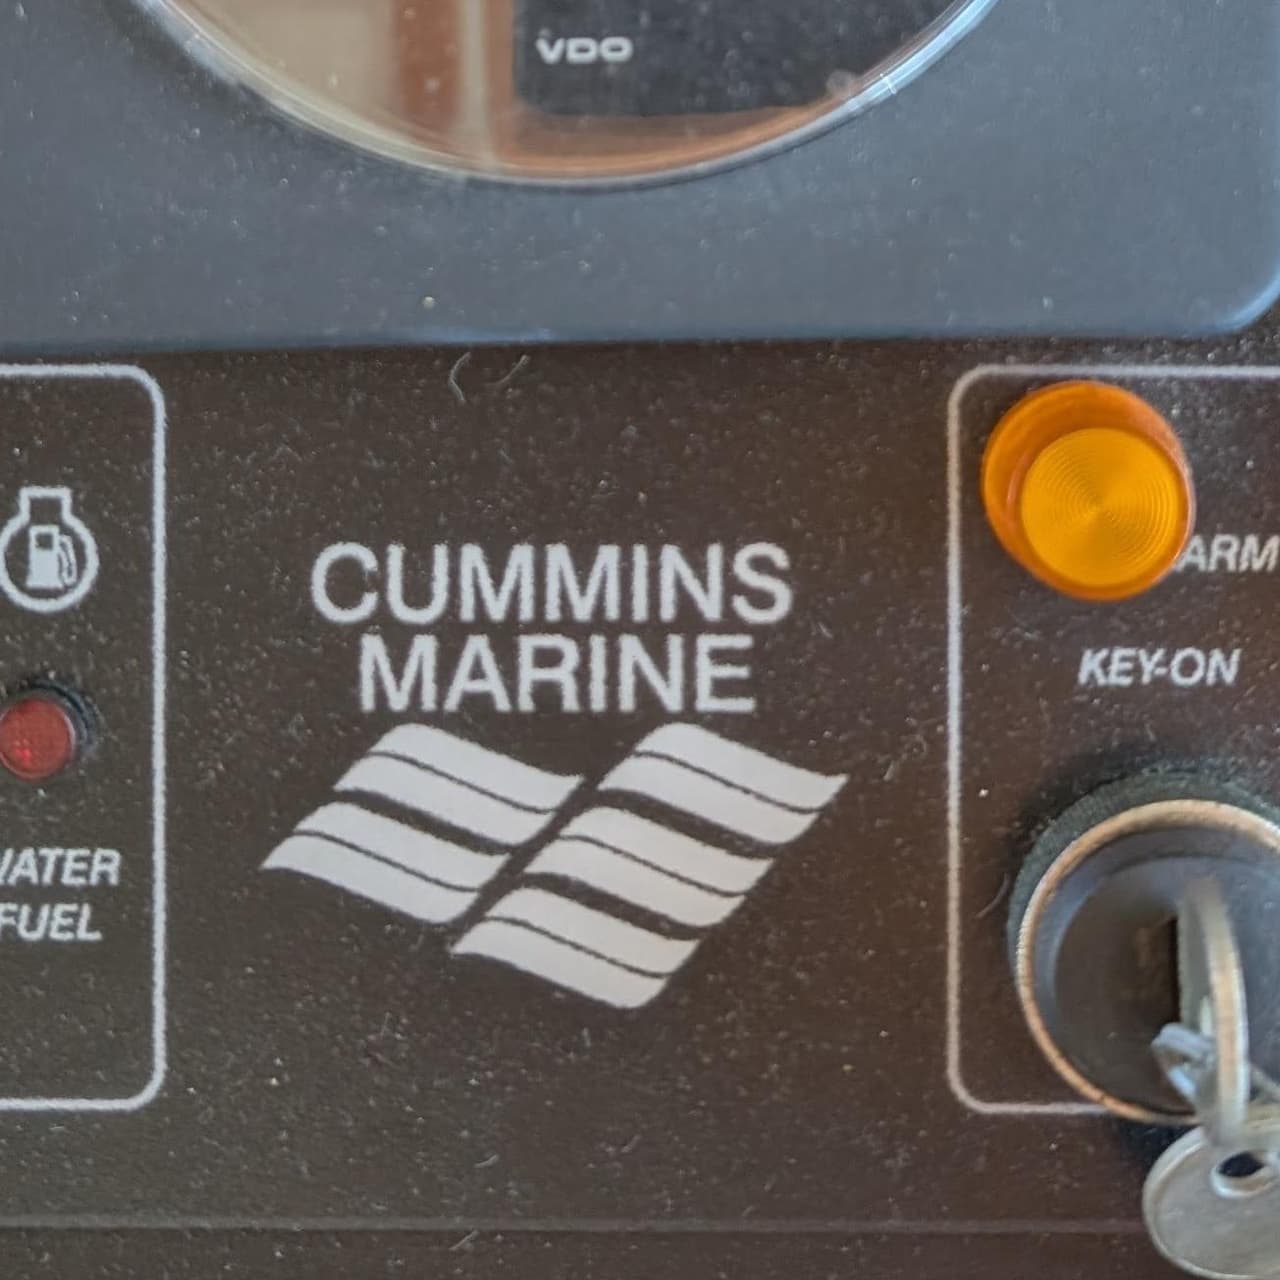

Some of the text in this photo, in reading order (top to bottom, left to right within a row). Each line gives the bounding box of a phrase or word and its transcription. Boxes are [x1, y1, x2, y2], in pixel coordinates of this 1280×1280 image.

[535, 35, 634, 65] VDO
[1175, 533, 1280, 573] ARM
[310, 542, 793, 623] CUMMINS
[358, 633, 755, 713] MARINE
[1078, 648, 1241, 687] KEY-ON
